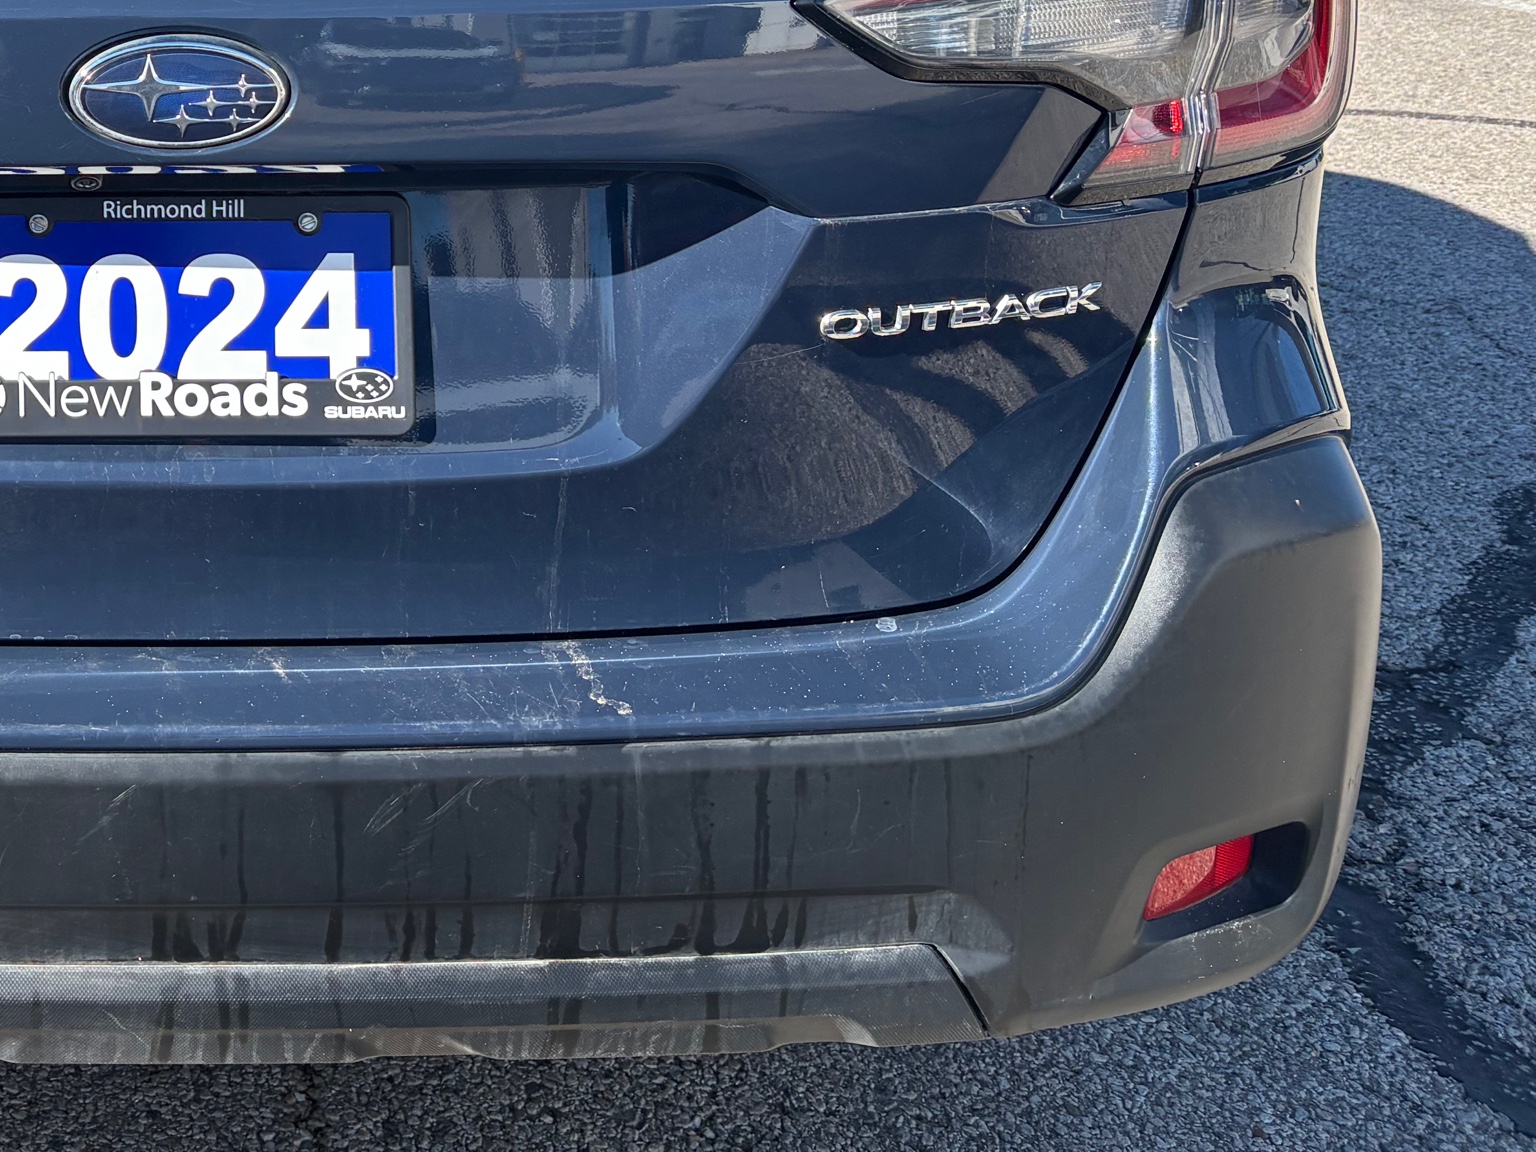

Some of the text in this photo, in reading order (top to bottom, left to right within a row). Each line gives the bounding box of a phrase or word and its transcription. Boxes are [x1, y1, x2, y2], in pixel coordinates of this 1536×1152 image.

[103, 200, 244, 219] Richmond Hill
[820, 282, 1102, 340] OUTBACK
[323, 404, 406, 419] SUBARU
